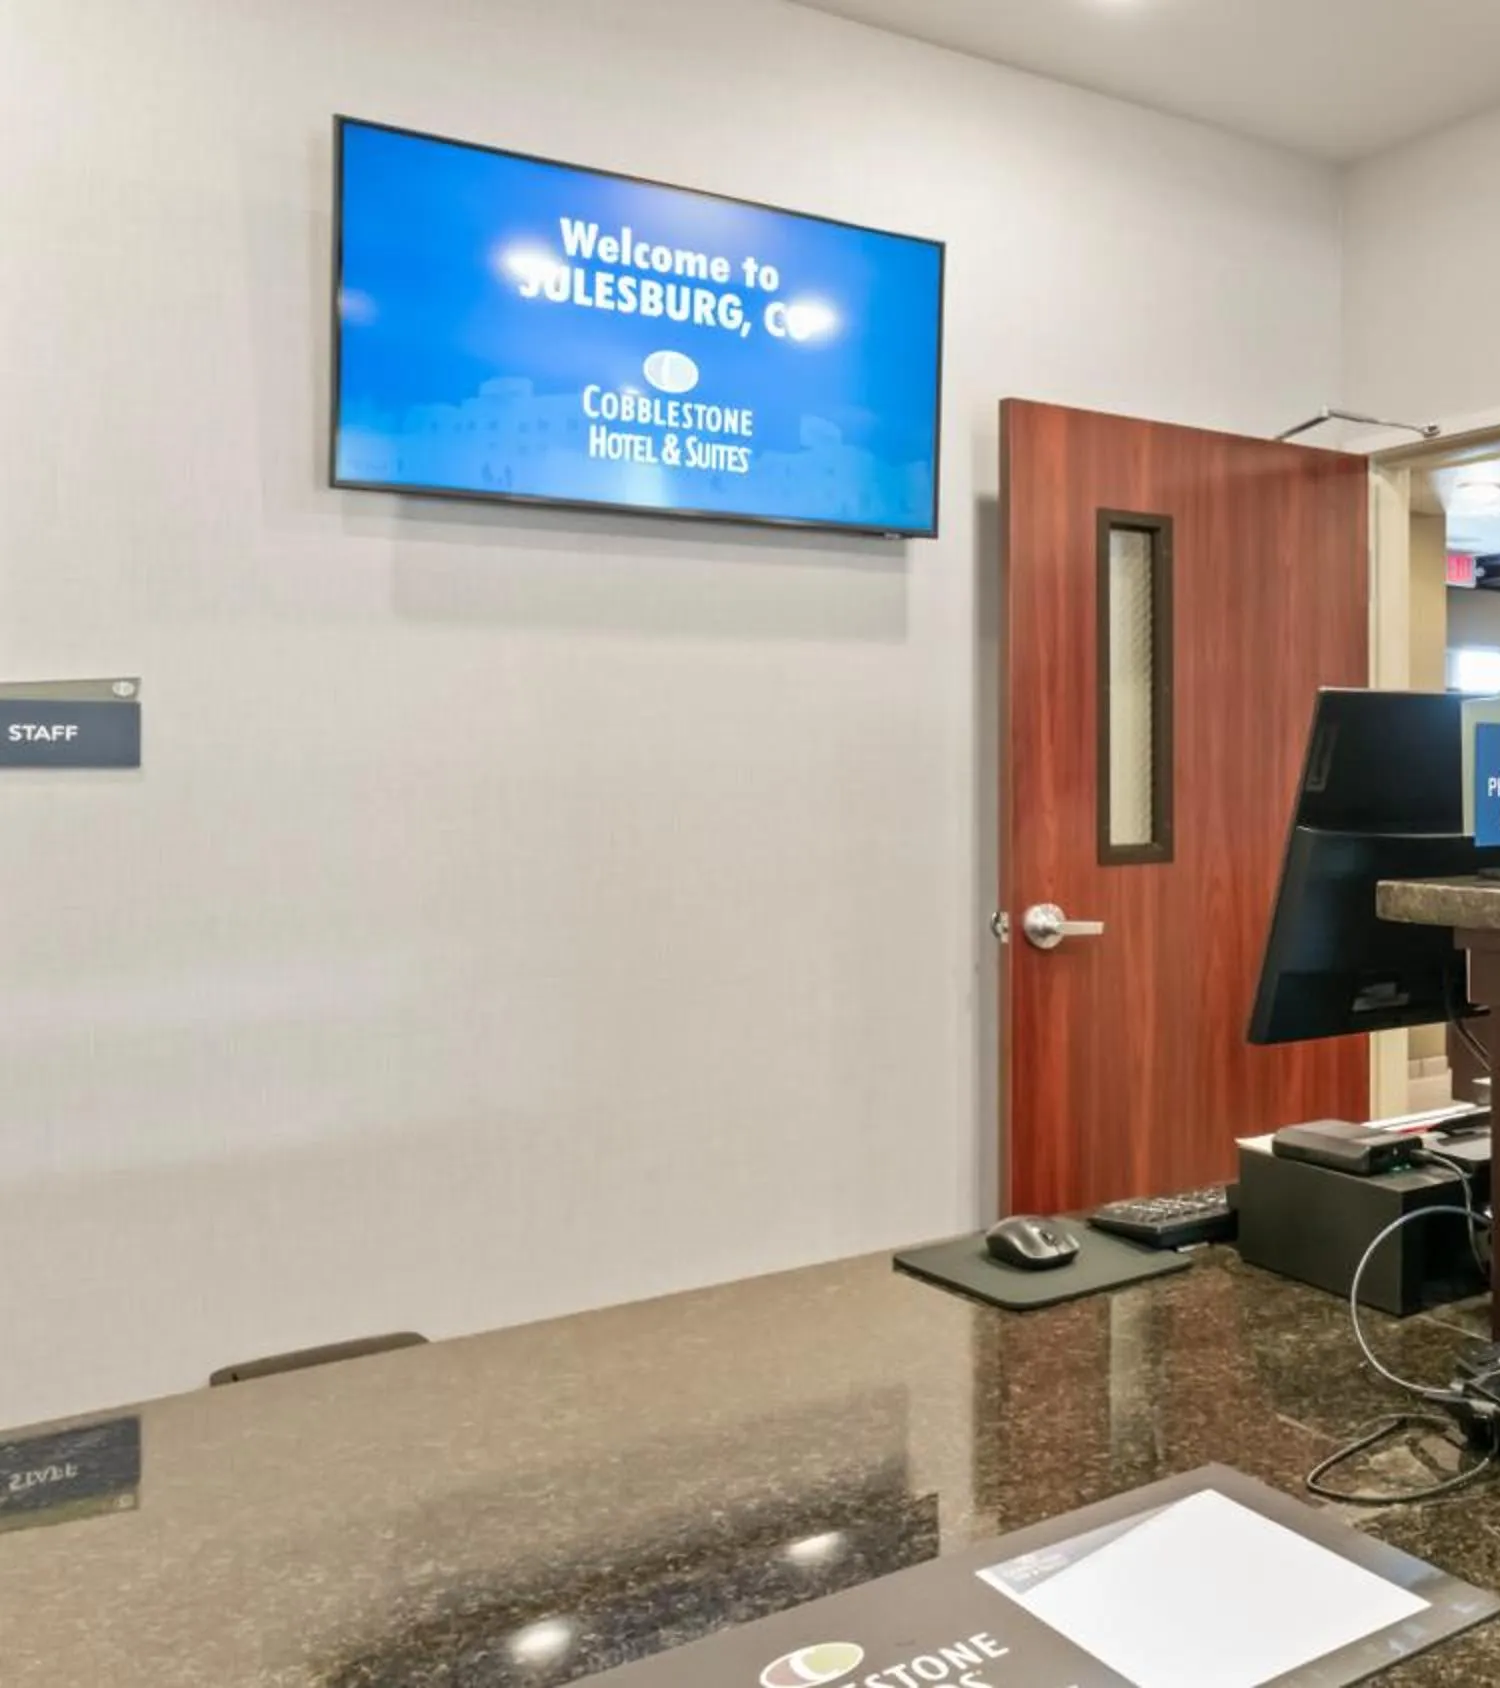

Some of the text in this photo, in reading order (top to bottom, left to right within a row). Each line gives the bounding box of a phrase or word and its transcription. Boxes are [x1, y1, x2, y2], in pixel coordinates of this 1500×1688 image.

[560, 216, 780, 292] Welcome to
[583, 384, 754, 437] COBBLESTONE
[589, 424, 753, 474] HOTEL & SUITES
[8, 724, 78, 742] STAFF
[841, 1632, 1009, 1688] STONE
